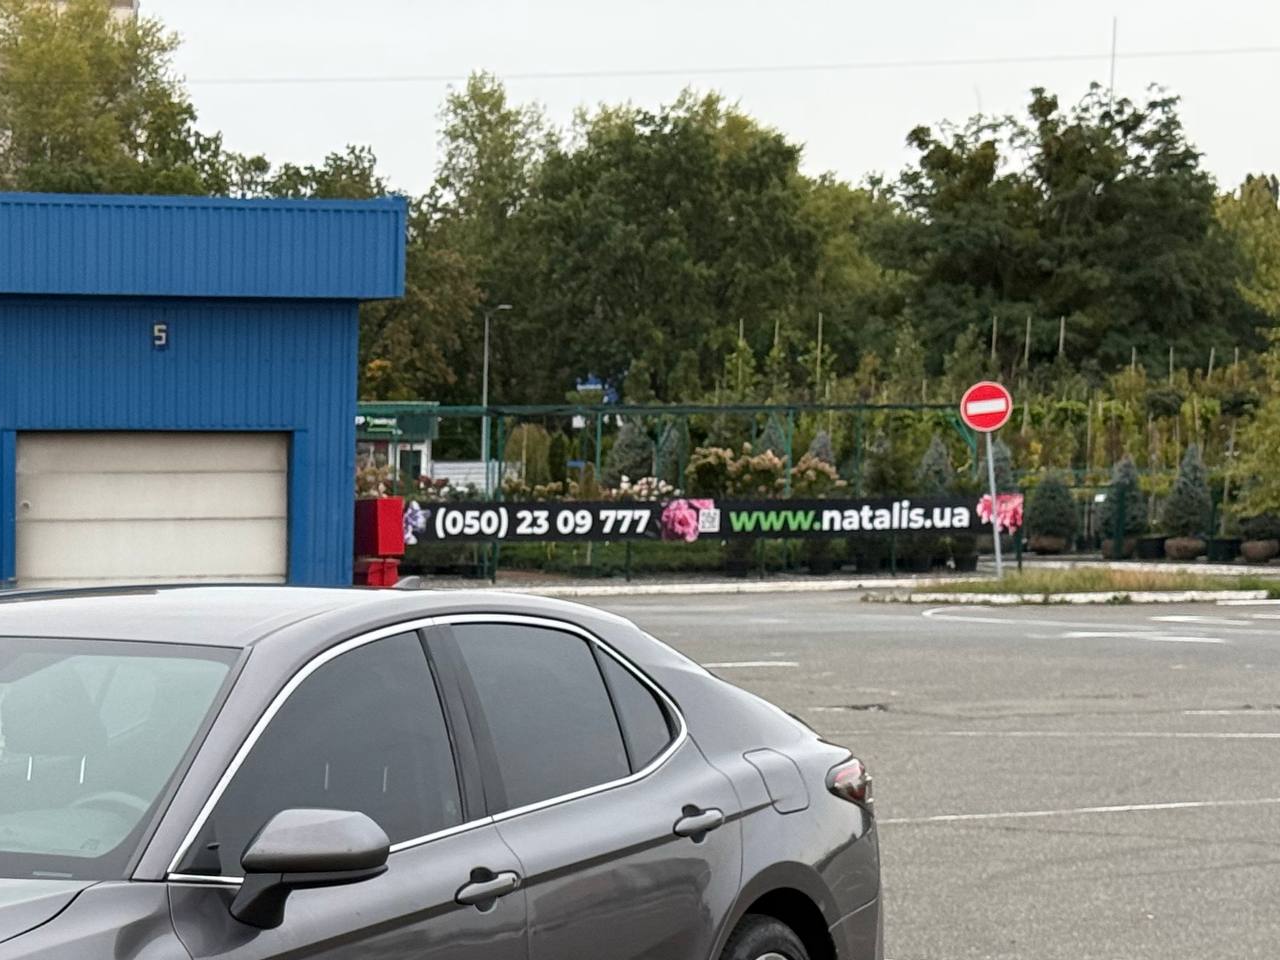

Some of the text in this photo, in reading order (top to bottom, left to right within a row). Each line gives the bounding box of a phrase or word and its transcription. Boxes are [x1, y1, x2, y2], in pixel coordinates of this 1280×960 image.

[153, 324, 168, 345] 5
[434, 507, 651, 539] (050) 23 09 777
[729, 499, 970, 532] www.natalis.ua
